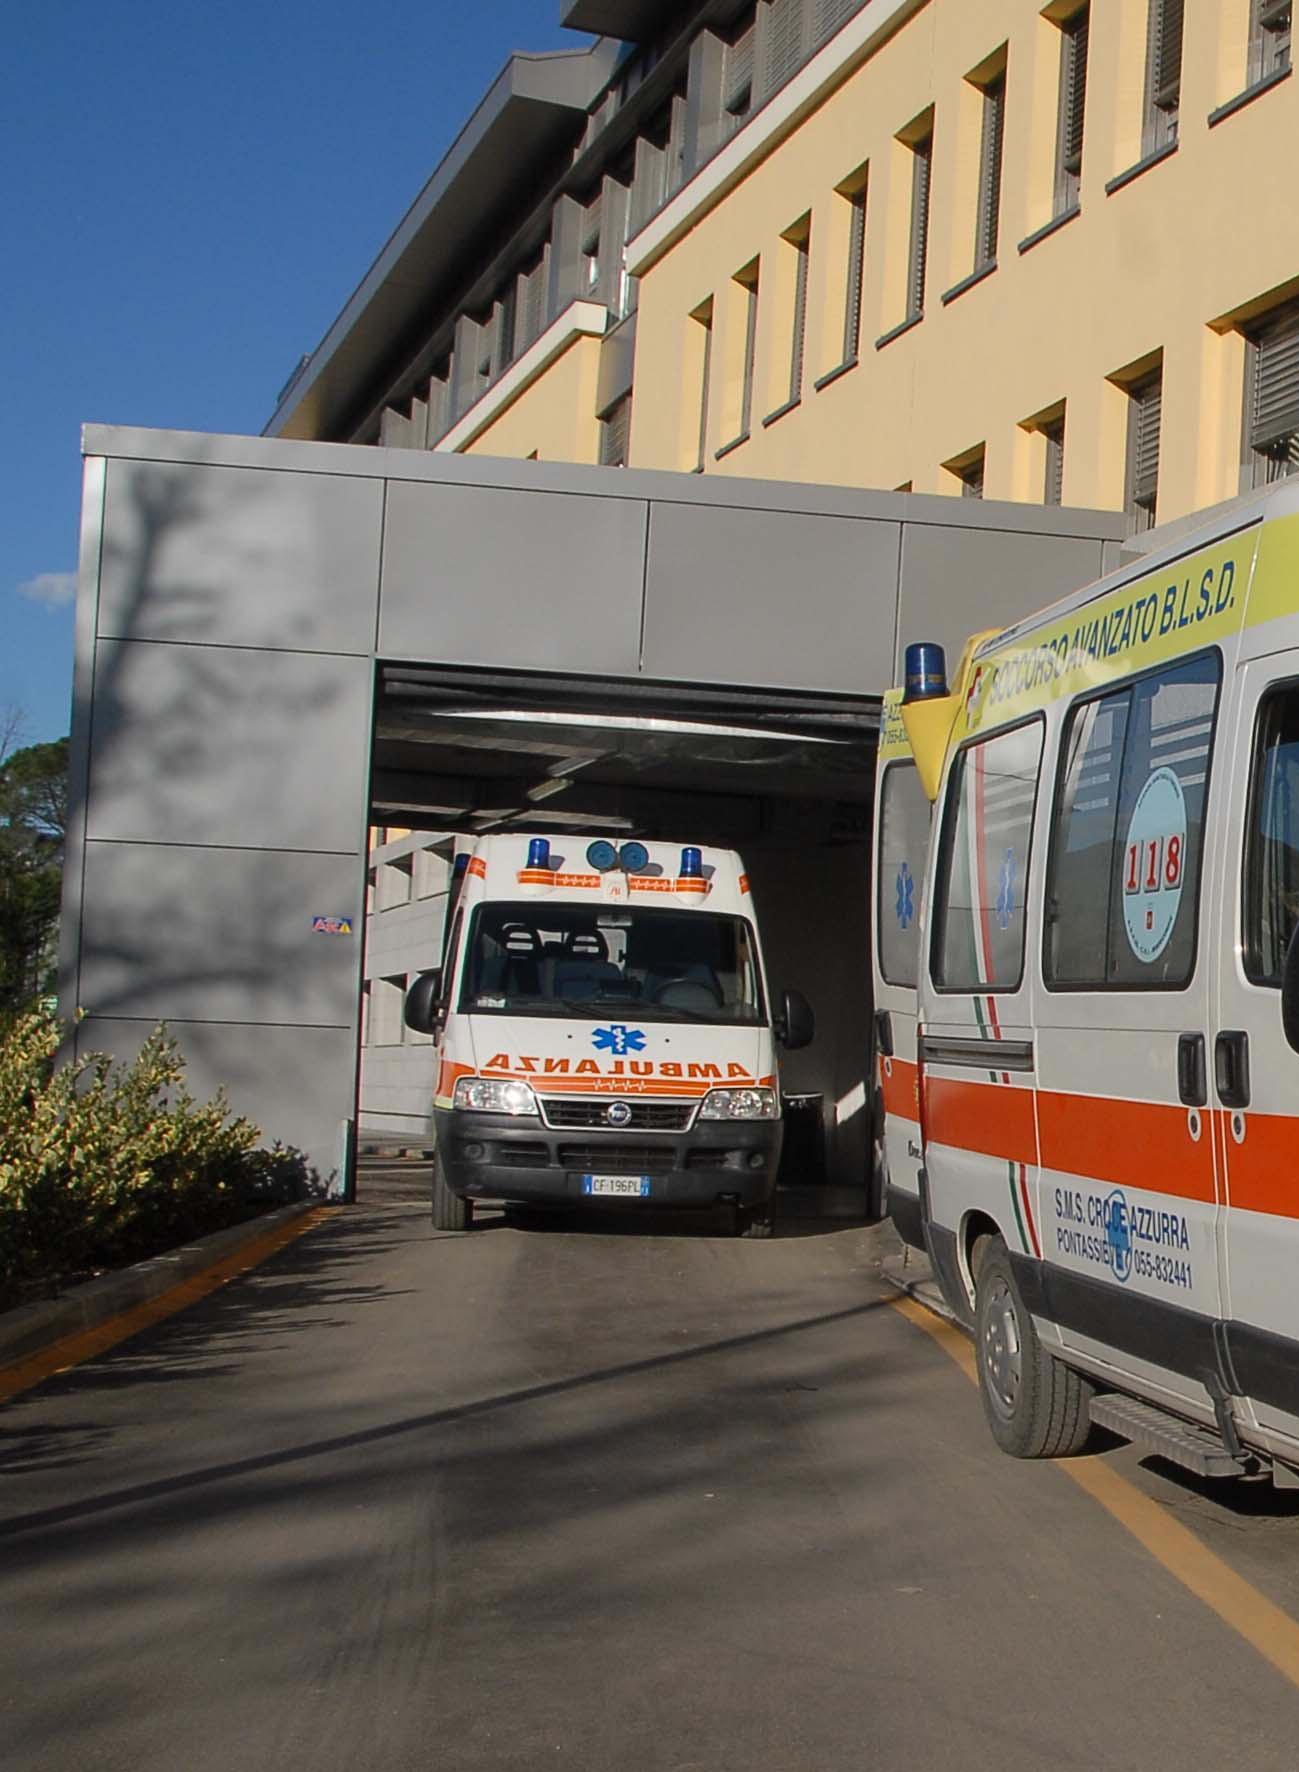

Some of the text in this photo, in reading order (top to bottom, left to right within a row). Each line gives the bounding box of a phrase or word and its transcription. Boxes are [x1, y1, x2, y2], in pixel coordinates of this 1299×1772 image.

[1066, 593, 1159, 673] AVANZATO
[1159, 560, 1236, 636] B.L.S.D.
[1127, 834, 1182, 889] 118
[1055, 1187, 1190, 1250] S.M.S. CROCE AZZURRA
[1056, 1227, 1193, 1290] PONTASSIEVE 055-832441
